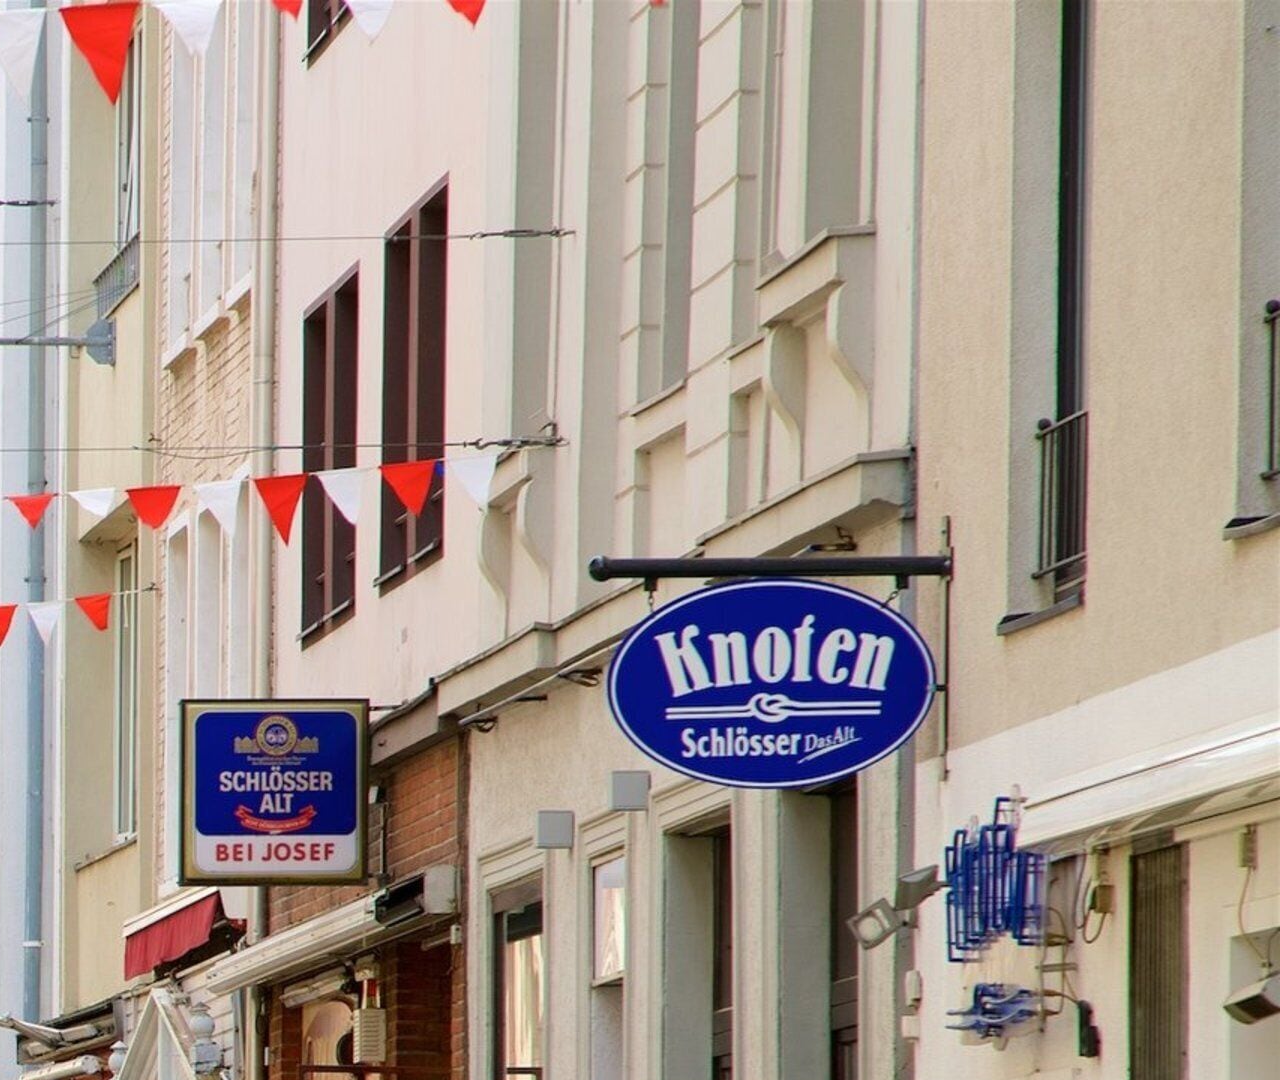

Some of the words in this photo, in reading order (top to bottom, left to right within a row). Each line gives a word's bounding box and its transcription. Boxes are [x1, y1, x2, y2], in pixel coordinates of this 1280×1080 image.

[681, 727, 802, 758] Schlösser
[219, 766, 333, 792] SCHLÖSSER
[259, 793, 294, 814] ALT
[216, 843, 253, 862] BEI
[261, 843, 335, 862] JOSEF
